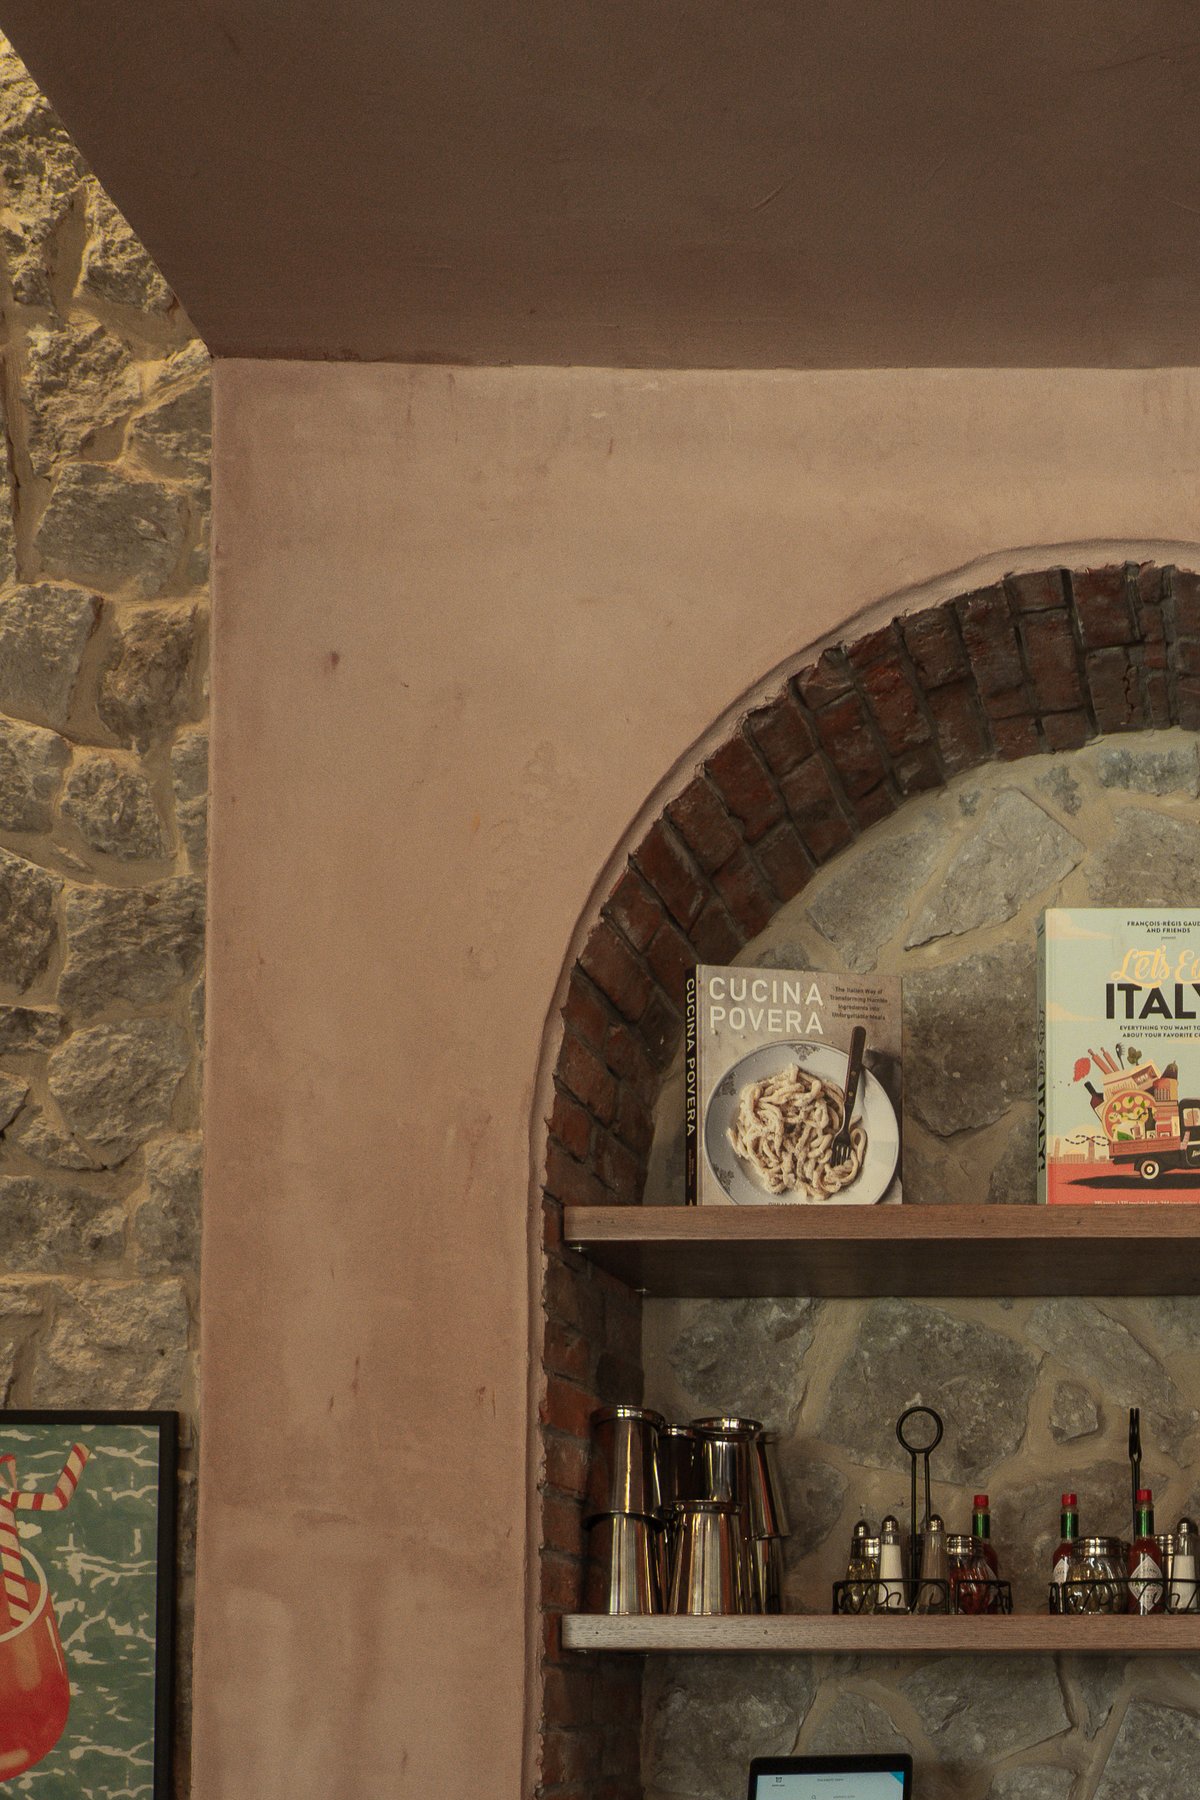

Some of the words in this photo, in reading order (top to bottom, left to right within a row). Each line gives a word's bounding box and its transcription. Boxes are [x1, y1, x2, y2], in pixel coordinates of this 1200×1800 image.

[686, 978, 696, 1052] CUCINA
[709, 976, 824, 1007] CUCINA
[709, 1005, 824, 1035] POVERA
[686, 1058, 696, 1137] POVERA
[1037, 1080, 1046, 1173] ITALY!
